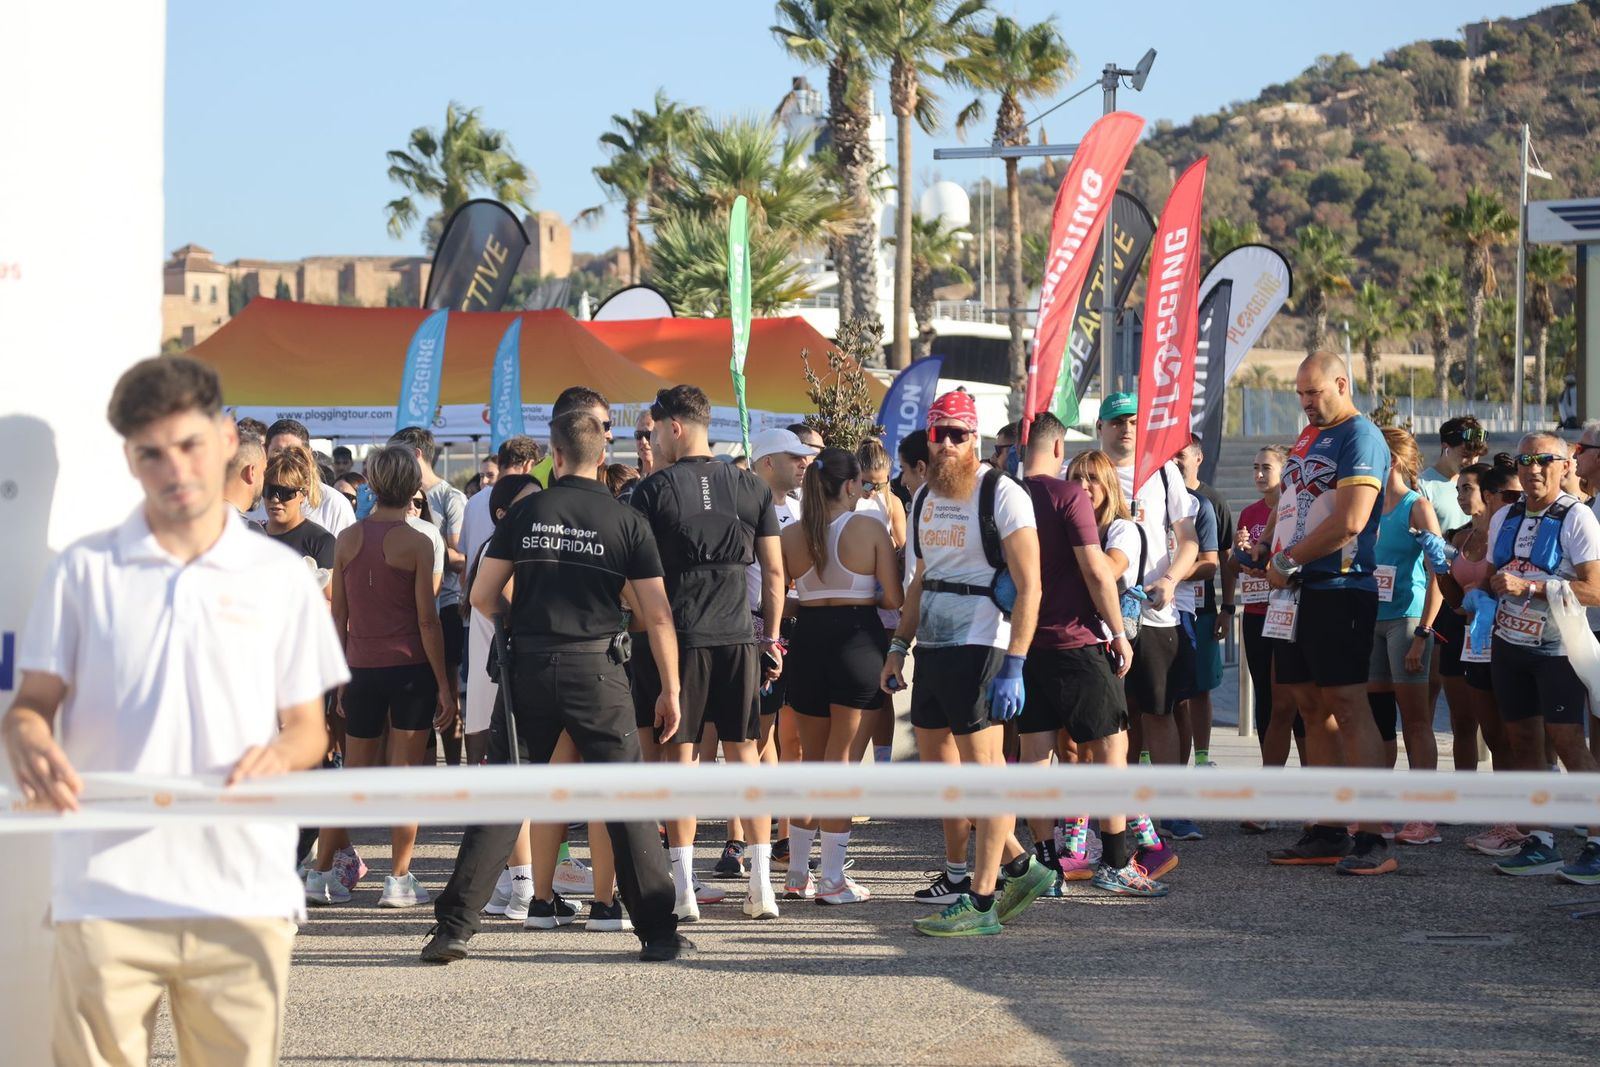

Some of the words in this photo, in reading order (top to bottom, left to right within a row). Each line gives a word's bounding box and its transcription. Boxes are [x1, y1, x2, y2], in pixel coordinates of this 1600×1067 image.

[1146, 227, 1188, 431] PLOGGING
[407, 338, 435, 427] LOGGING
[276, 408, 393, 421] www.ploggingtour.com
[701, 476, 712, 510] KIPRUN
[531, 522, 598, 539] MenKeeper
[522, 536, 604, 556] SEGURIDAD
[1244, 581, 1270, 592] 2438
[1499, 612, 1539, 634] 24374
